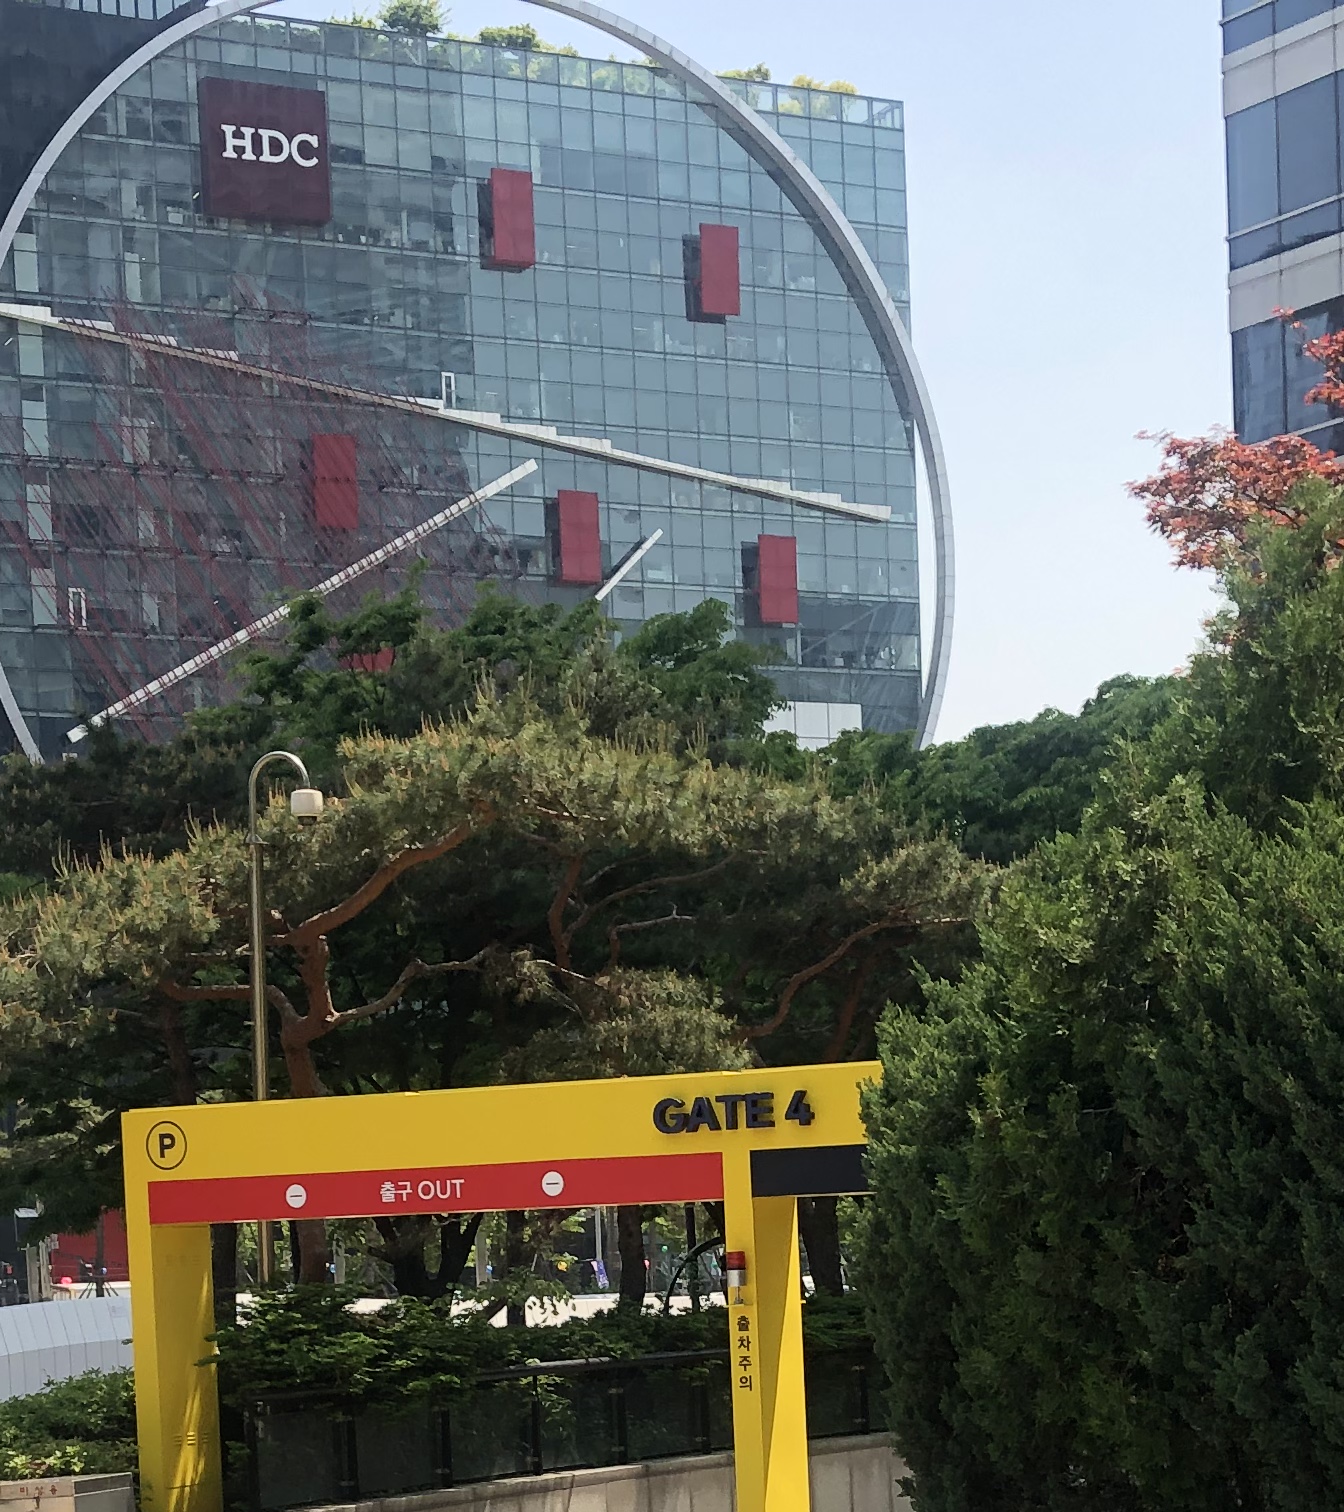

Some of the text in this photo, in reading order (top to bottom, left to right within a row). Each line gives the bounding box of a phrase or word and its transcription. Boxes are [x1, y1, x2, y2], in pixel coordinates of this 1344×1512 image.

[220, 124, 319, 168] HDC
[653, 1090, 815, 1134] GATE 4
[158, 1133, 176, 1158] P
[380, 1178, 465, 1203] 출구 OUT
[736, 1315, 753, 1392] 출차주의
